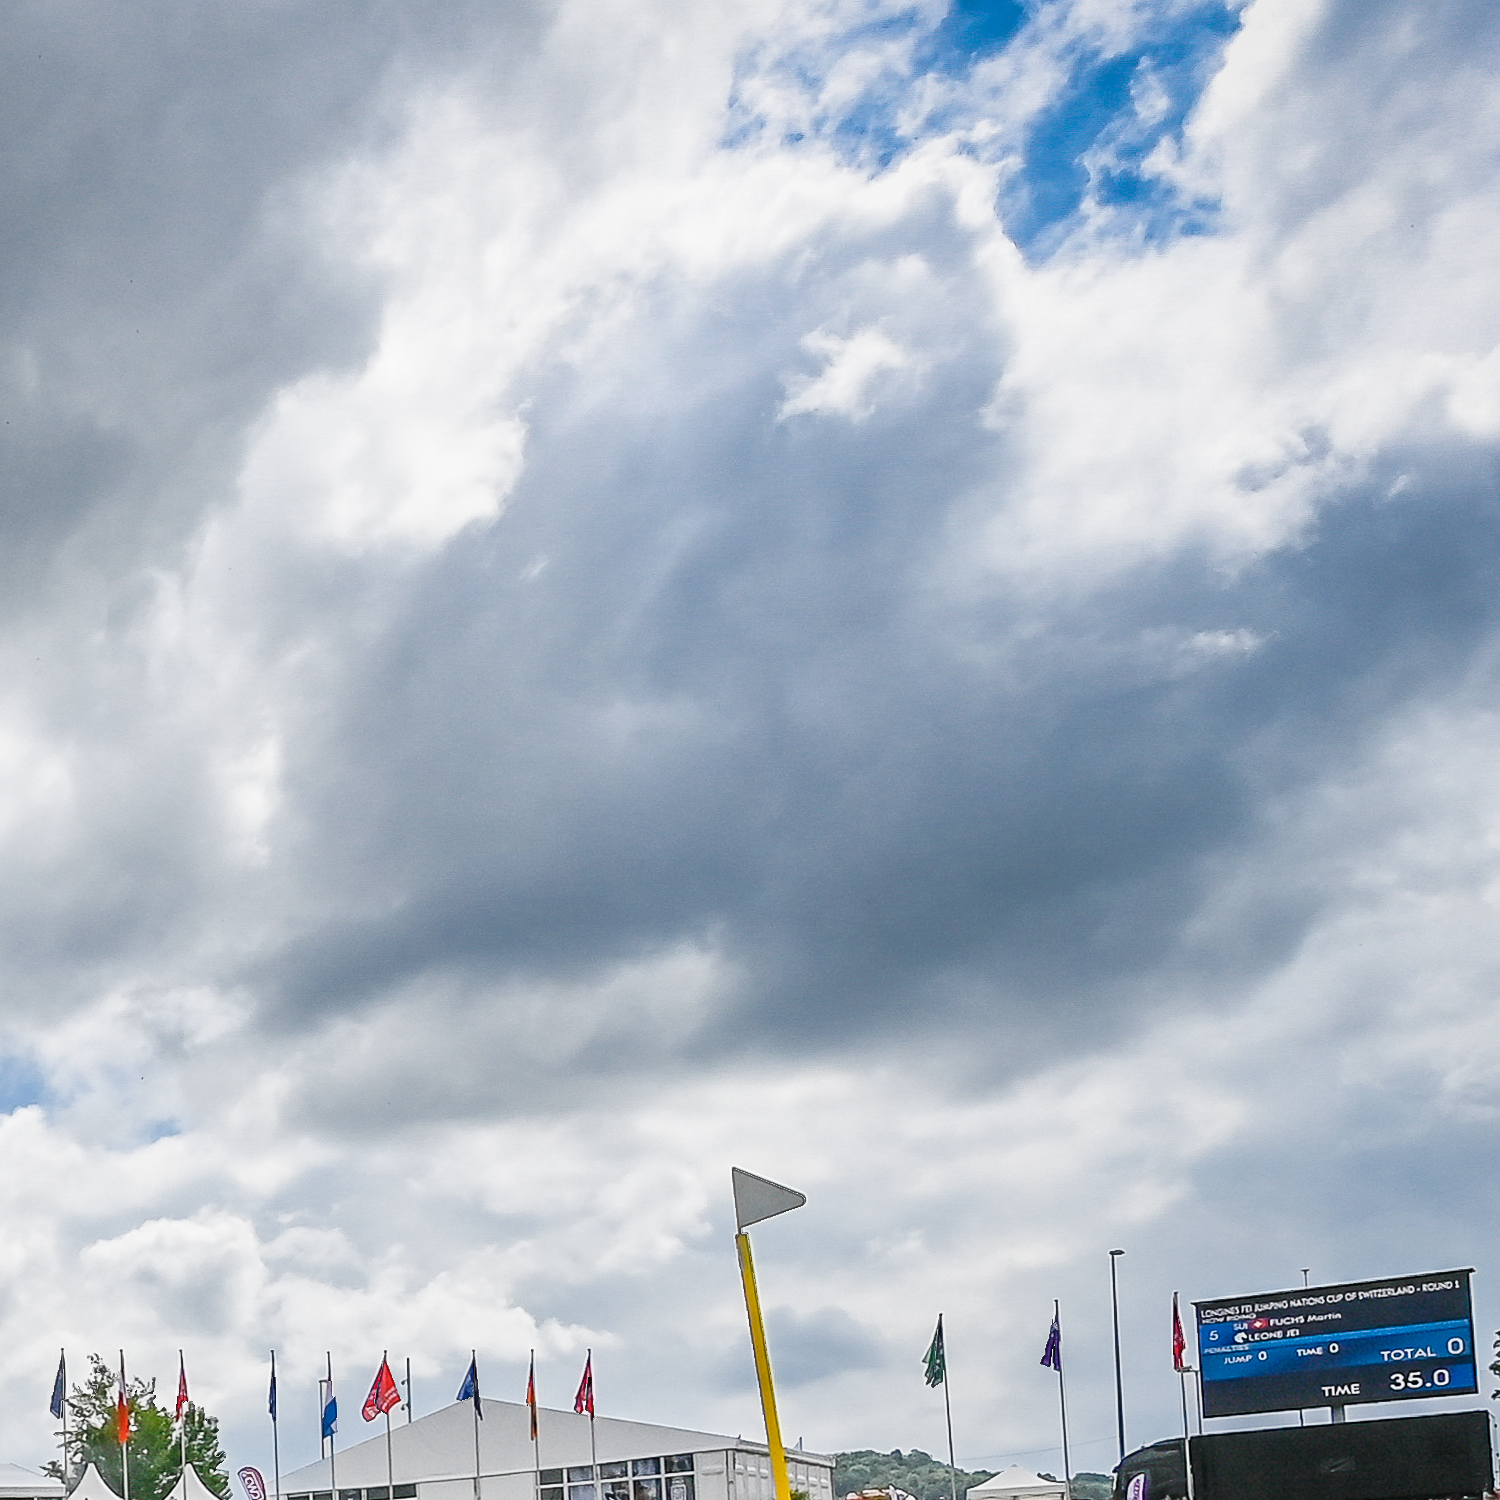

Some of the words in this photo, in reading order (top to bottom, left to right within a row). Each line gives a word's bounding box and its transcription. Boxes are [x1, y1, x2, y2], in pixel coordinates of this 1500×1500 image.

[1290, 1295, 1325, 1308] NATIONS
[1326, 1293, 1344, 1303] CUP
[1345, 1292, 1357, 1301] OF
[1358, 1285, 1415, 1300] SWITZERLAND
[1422, 1281, 1453, 1292] ROUND
[1454, 1280, 1460, 1288] 1
[1269, 1316, 1304, 1327] FUCHS
[1307, 1312, 1341, 1323] Martin
[1208, 1330, 1218, 1341] 5
[1296, 1346, 1323, 1357] TIME
[1329, 1342, 1339, 1354] 0
[1380, 1346, 1436, 1361] TOTAL
[1447, 1337, 1463, 1355] 0
[1223, 1354, 1252, 1365] JUMP
[1258, 1350, 1267, 1361] 0
[1321, 1383, 1360, 1398] TIME
[1389, 1368, 1449, 1391] 35.0
